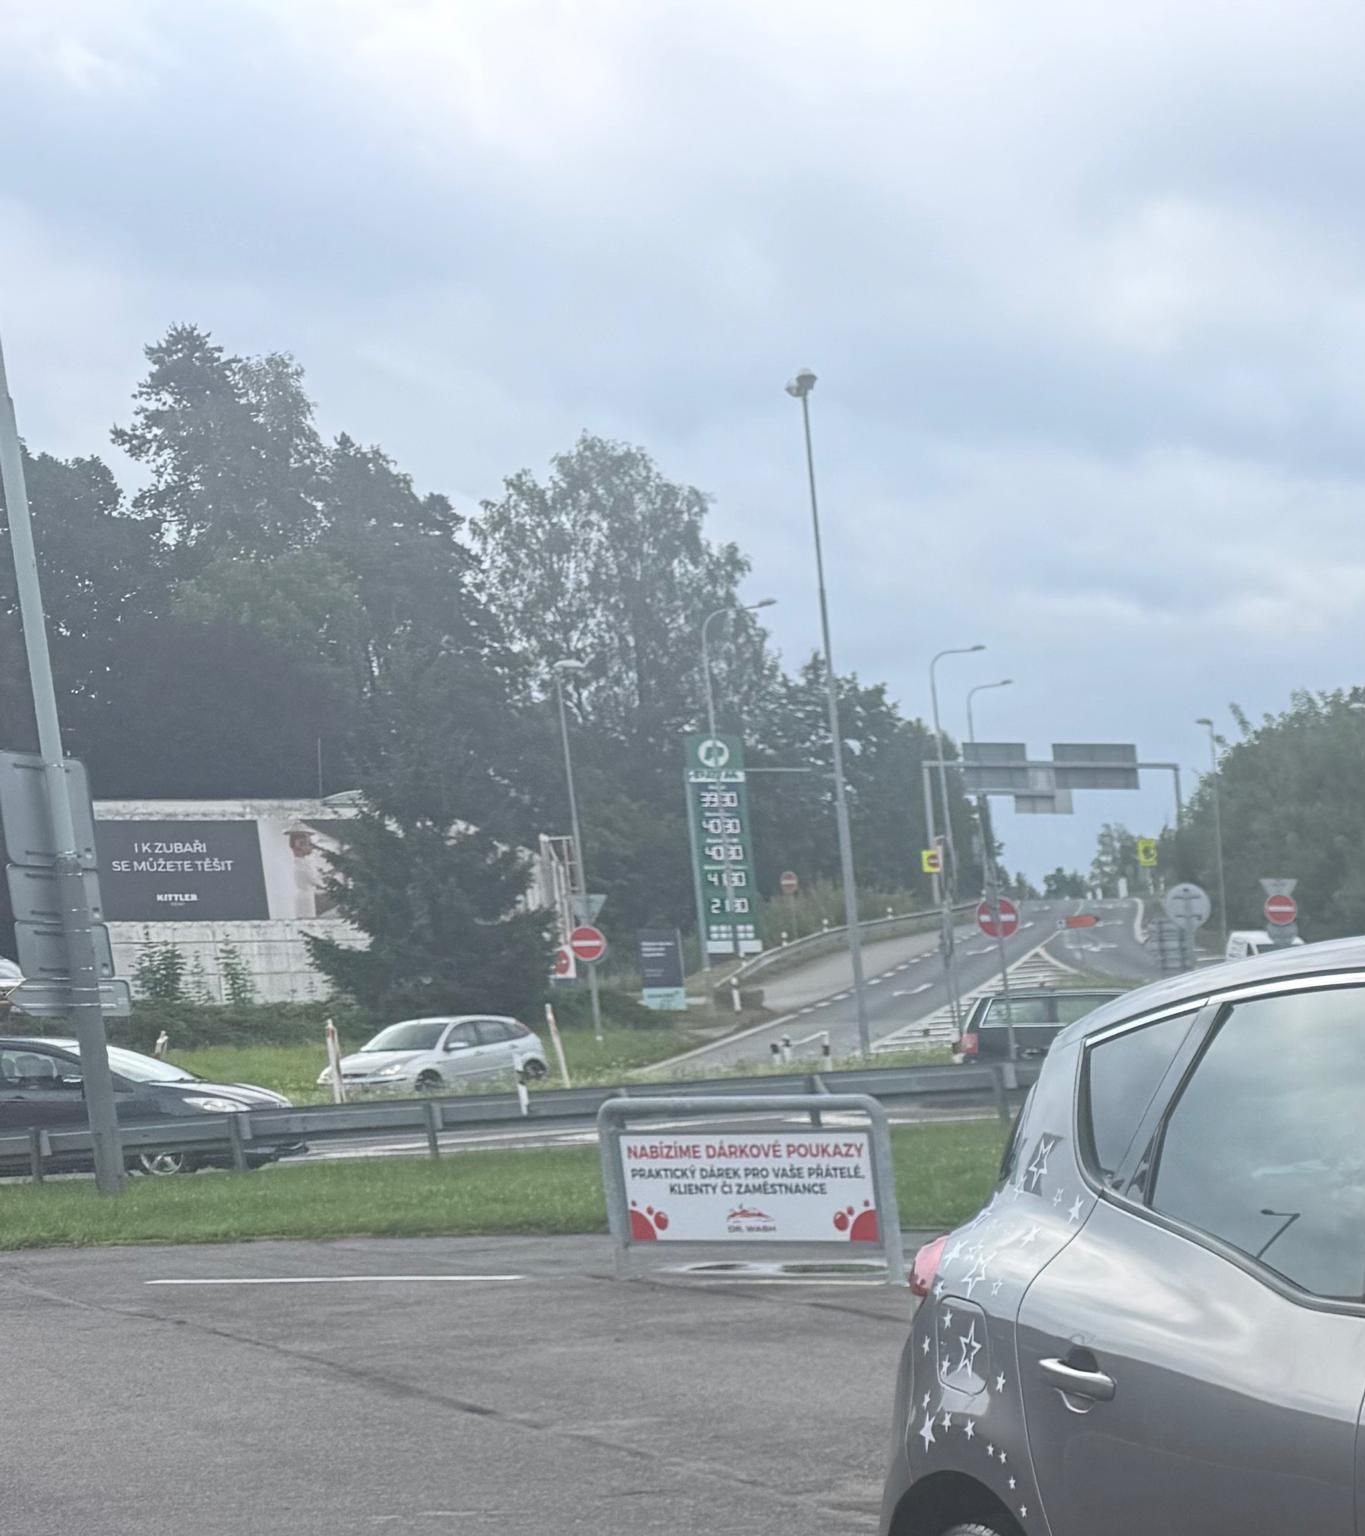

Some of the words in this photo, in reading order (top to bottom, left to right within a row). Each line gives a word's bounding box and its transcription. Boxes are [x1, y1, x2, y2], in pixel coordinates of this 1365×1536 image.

[142, 842, 151, 853] K
[154, 840, 207, 853] ZUBAŘI
[112, 860, 131, 872] SE
[134, 857, 194, 872] MŮŽETE
[195, 857, 234, 872] TĚŠIT
[627, 1140, 701, 1159] NABÍZÍME
[705, 1139, 782, 1159] DÁRKOVÉ
[786, 1143, 864, 1158] POUKAZY
[631, 1164, 697, 1179] PRAKTICKÝ
[700, 1164, 740, 1179] DÁREK
[744, 1167, 769, 1179] PRO
[772, 1164, 804, 1179] VAŠE
[669, 1183, 718, 1195] KLIENTY
[721, 1181, 733, 1195] ČI
[735, 1181, 828, 1195] ZAMĚSTNANCE
